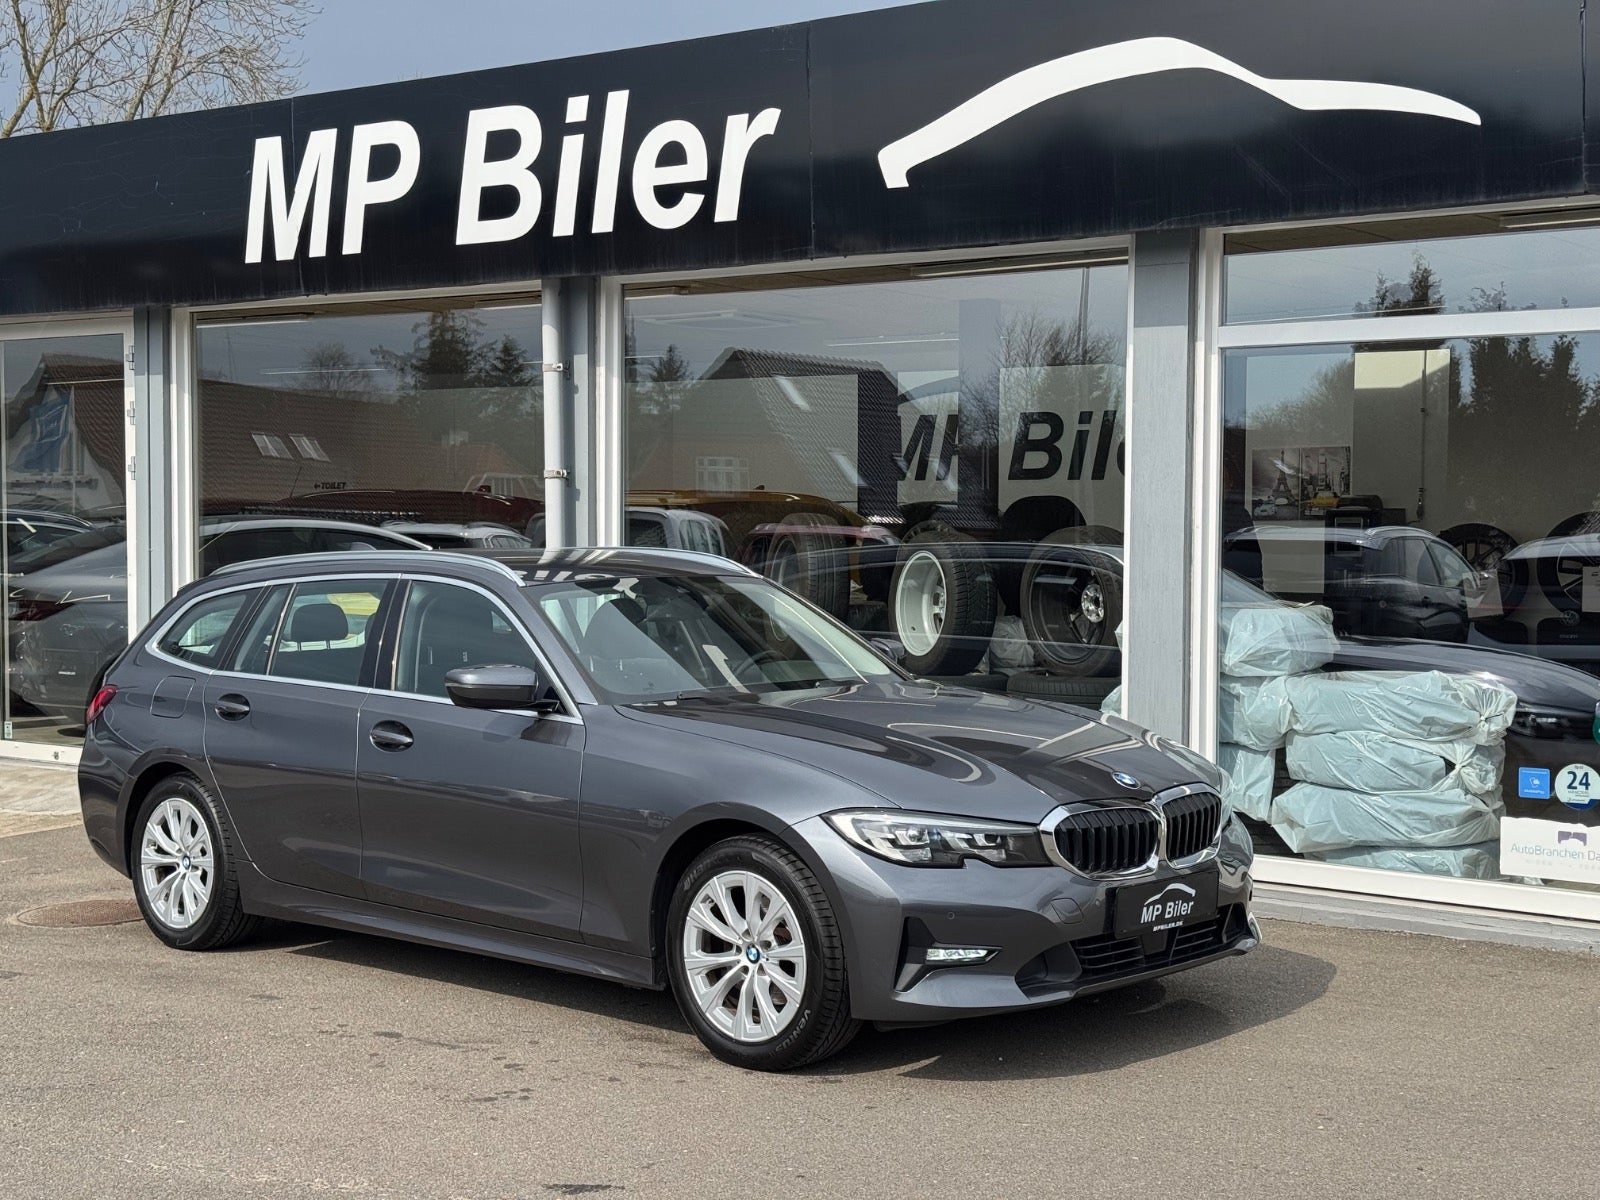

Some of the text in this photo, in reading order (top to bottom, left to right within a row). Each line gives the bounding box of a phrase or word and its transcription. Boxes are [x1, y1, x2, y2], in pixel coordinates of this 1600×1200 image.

[244, 89, 781, 264] MP Biler
[1008, 409, 1125, 481] Bil
[321, 481, 347, 490] TOILET
[1566, 770, 1591, 790] 24
[1510, 842, 1585, 859] AutoBranchen
[1140, 899, 1194, 923] MP Biler
